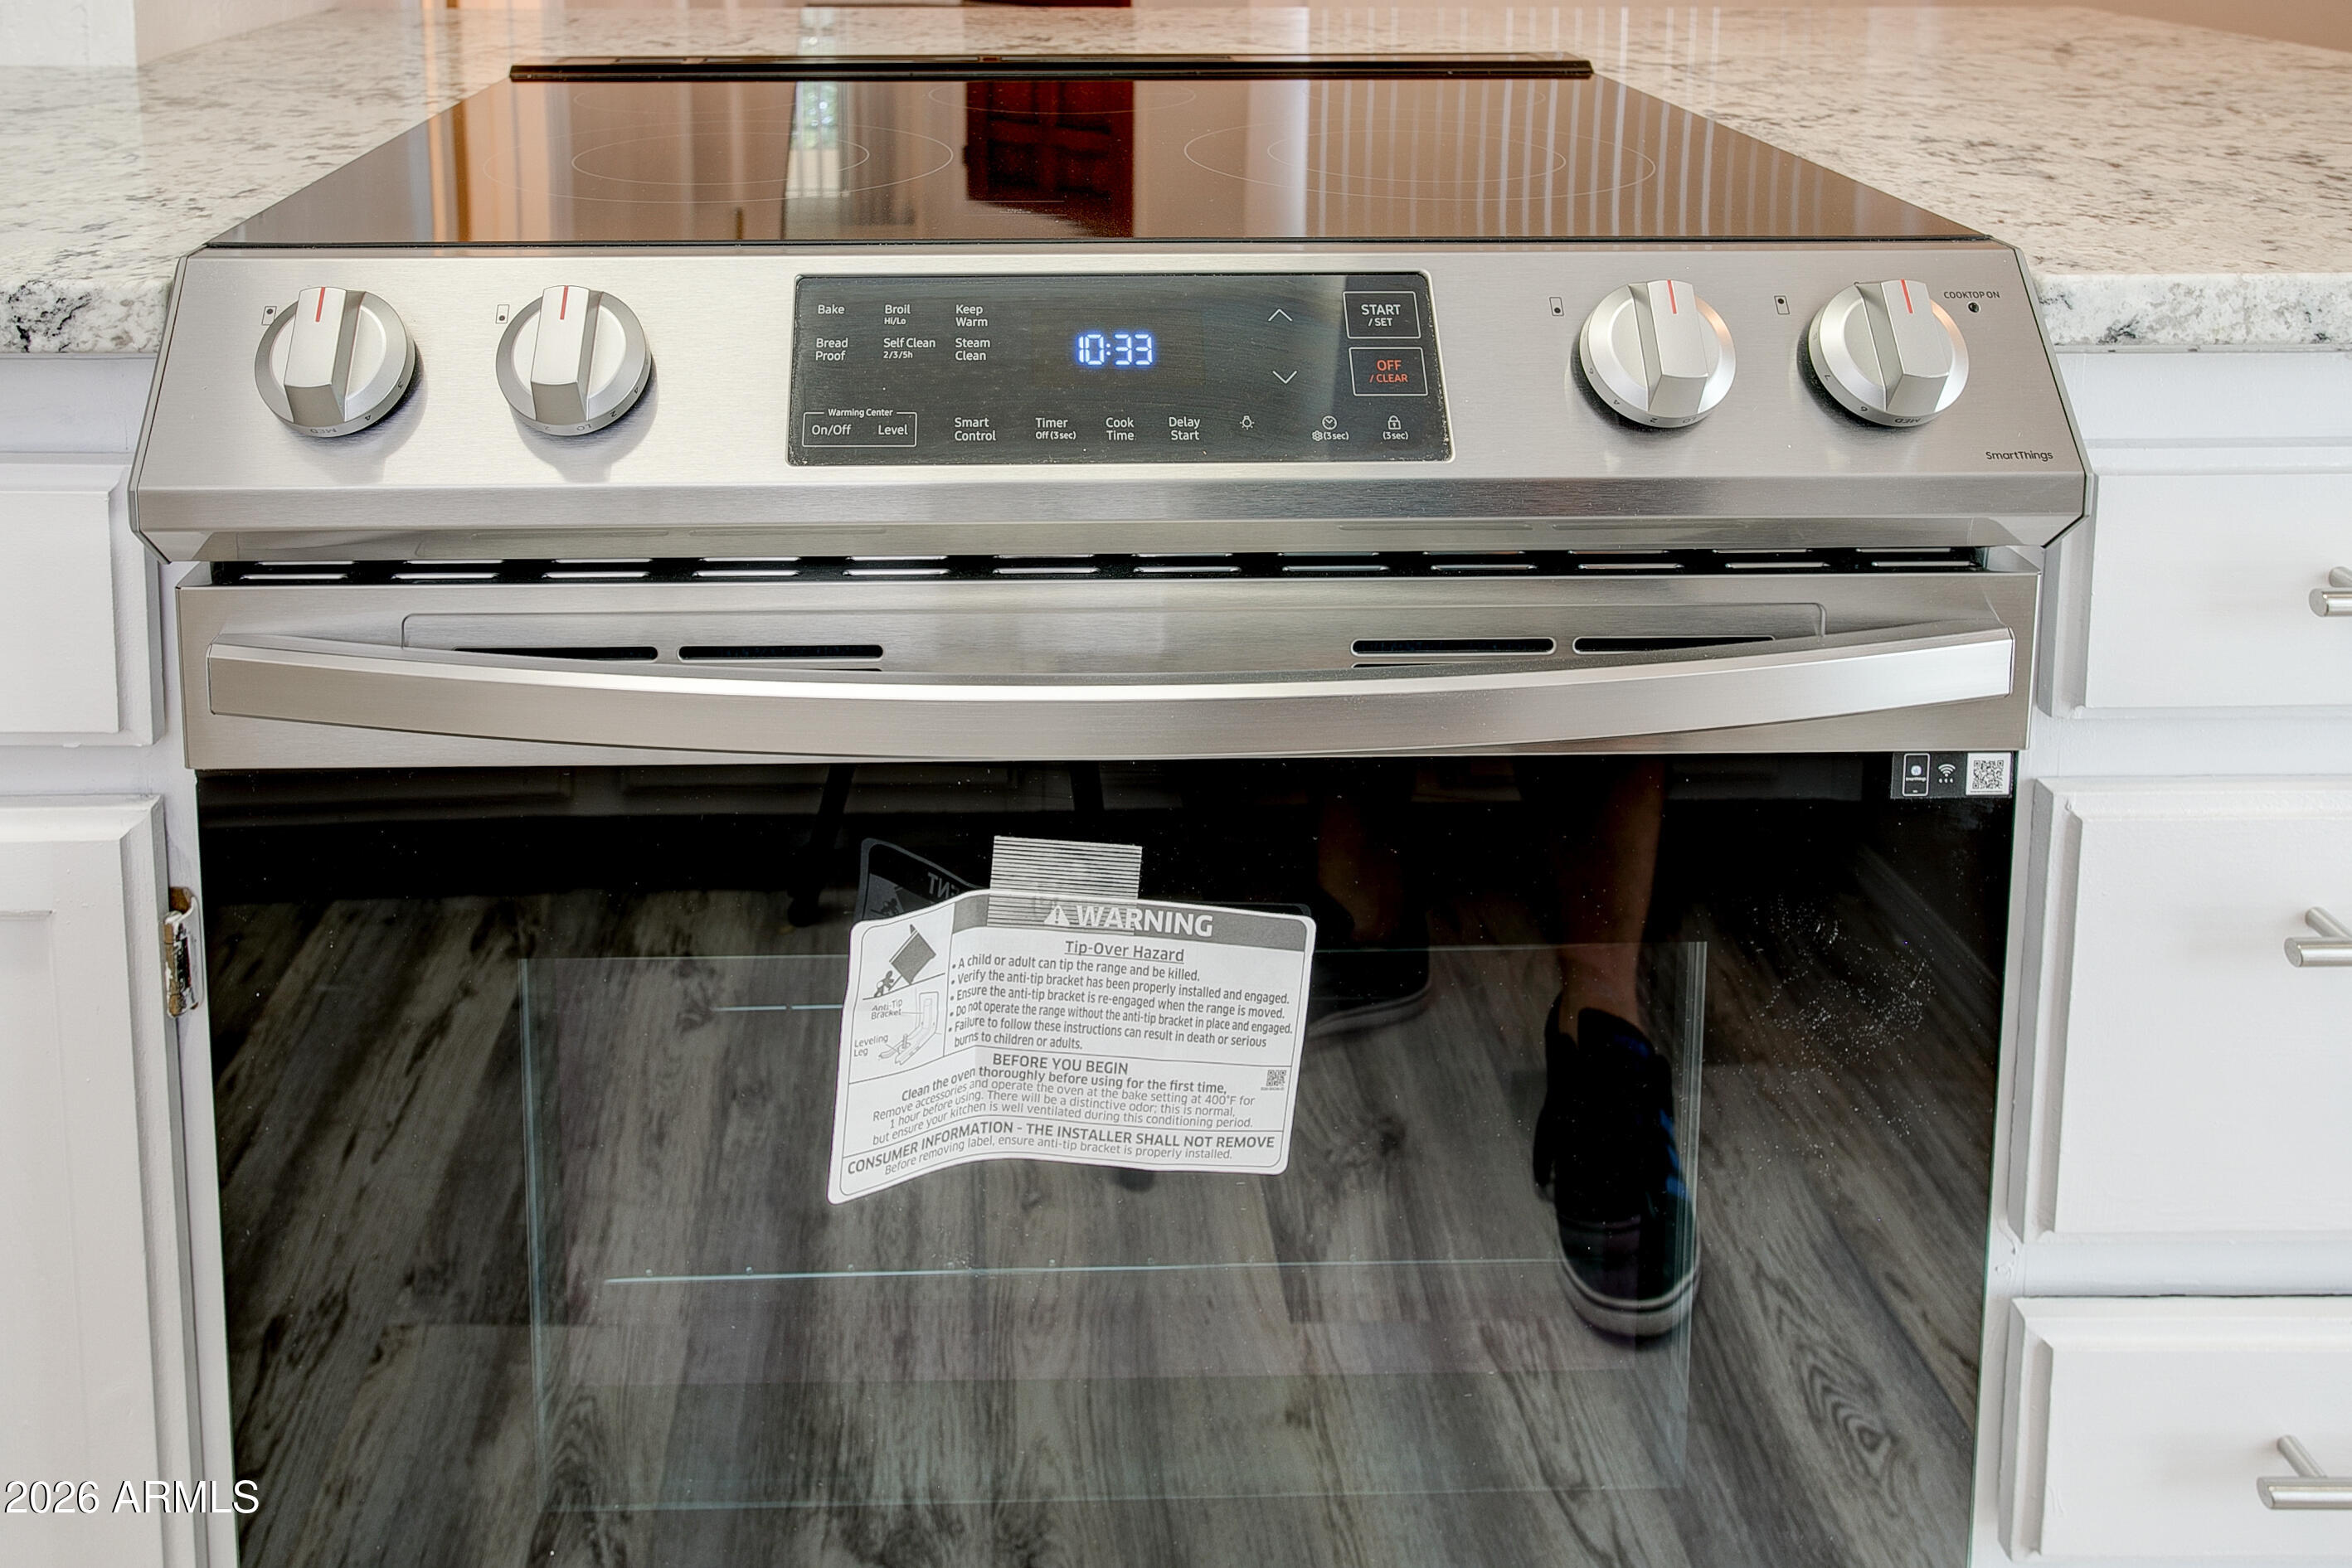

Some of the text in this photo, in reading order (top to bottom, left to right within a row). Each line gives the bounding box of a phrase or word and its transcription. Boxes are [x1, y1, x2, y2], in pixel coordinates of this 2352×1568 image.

[817, 304, 845, 315] Bake
[884, 304, 911, 315] Broil
[955, 304, 984, 316] Keep
[1361, 303, 1401, 315] START
[883, 317, 906, 325] Hi/Lo
[955, 317, 989, 327] Warm
[815, 337, 848, 348] Bread
[883, 337, 936, 348] Self Clean
[955, 337, 991, 348] Steam
[883, 351, 913, 359] 2/3/5h
[955, 350, 987, 361] Clean
[1076, 333, 1154, 366] 10:33
[815, 350, 846, 362] Proof
[1376, 359, 1402, 371] OFF
[828, 408, 893, 418] Warming Center
[955, 417, 989, 428] Smart
[1035, 417, 1068, 428] Timer
[1106, 417, 1135, 429] Cook
[1168, 417, 1201, 430] Delay
[811, 424, 852, 435] On/Off
[877, 424, 908, 435] Level
[954, 430, 997, 441] Control
[1035, 431, 1049, 439] Off
[1106, 430, 1135, 441] Time
[1170, 430, 1200, 441] Start
[1985, 450, 2053, 462] SmartThings
[1076, 905, 1213, 937] WARNING
[1065, 940, 1184, 962] Tip-Over Hazard
[967, 954, 991, 967] child
[994, 957, 1005, 966] or
[1008, 955, 1036, 968] adult
[1038, 959, 1057, 969] can
[1059, 959, 1073, 972] tip
[1077, 960, 1093, 972] the
[1096, 962, 1127, 976] range
[1130, 965, 1149, 977] and
[1152, 966, 1165, 978] be
[1168, 968, 1200, 982] killed.
[957, 969, 1290, 1005] Verify the anti-tip bracket has been properly installed and engaged.
[871, 998, 903, 1012] Anti-Tip
[957, 985, 1285, 1019] Ensure the anti-tip bracket is re-engaged when the range is moved.
[871, 1008, 901, 1020] Bracket
[955, 1000, 1292, 1036] Do not operate the range without the anti-tip bracket in place and engaged.
[955, 1017, 1267, 1048] Failure to follow these instructions can result in death or serious
[854, 1035, 889, 1048] Leveling
[954, 1032, 1083, 1050] burns to children or adults.
[854, 1048, 868, 1057] Leg
[993, 1053, 1129, 1075] BEFORE YOU BEGIN
[901, 1066, 1227, 1101] Clean the oven thoroughly before using for the first time,
[848, 1141, 918, 1174] CONSUMER
[921, 1121, 1013, 1150] INFORMATION
[1027, 1124, 1053, 1136] THE
[1057, 1126, 1132, 1144] INSTALLER
[1135, 1133, 1180, 1148] SHALL
[1183, 1136, 1213, 1148] NOT
[1216, 1136, 1276, 1148] REMOVE
[884, 1135, 1232, 1176] Before removing label, ensure anti-tip bracket is properly installed.
